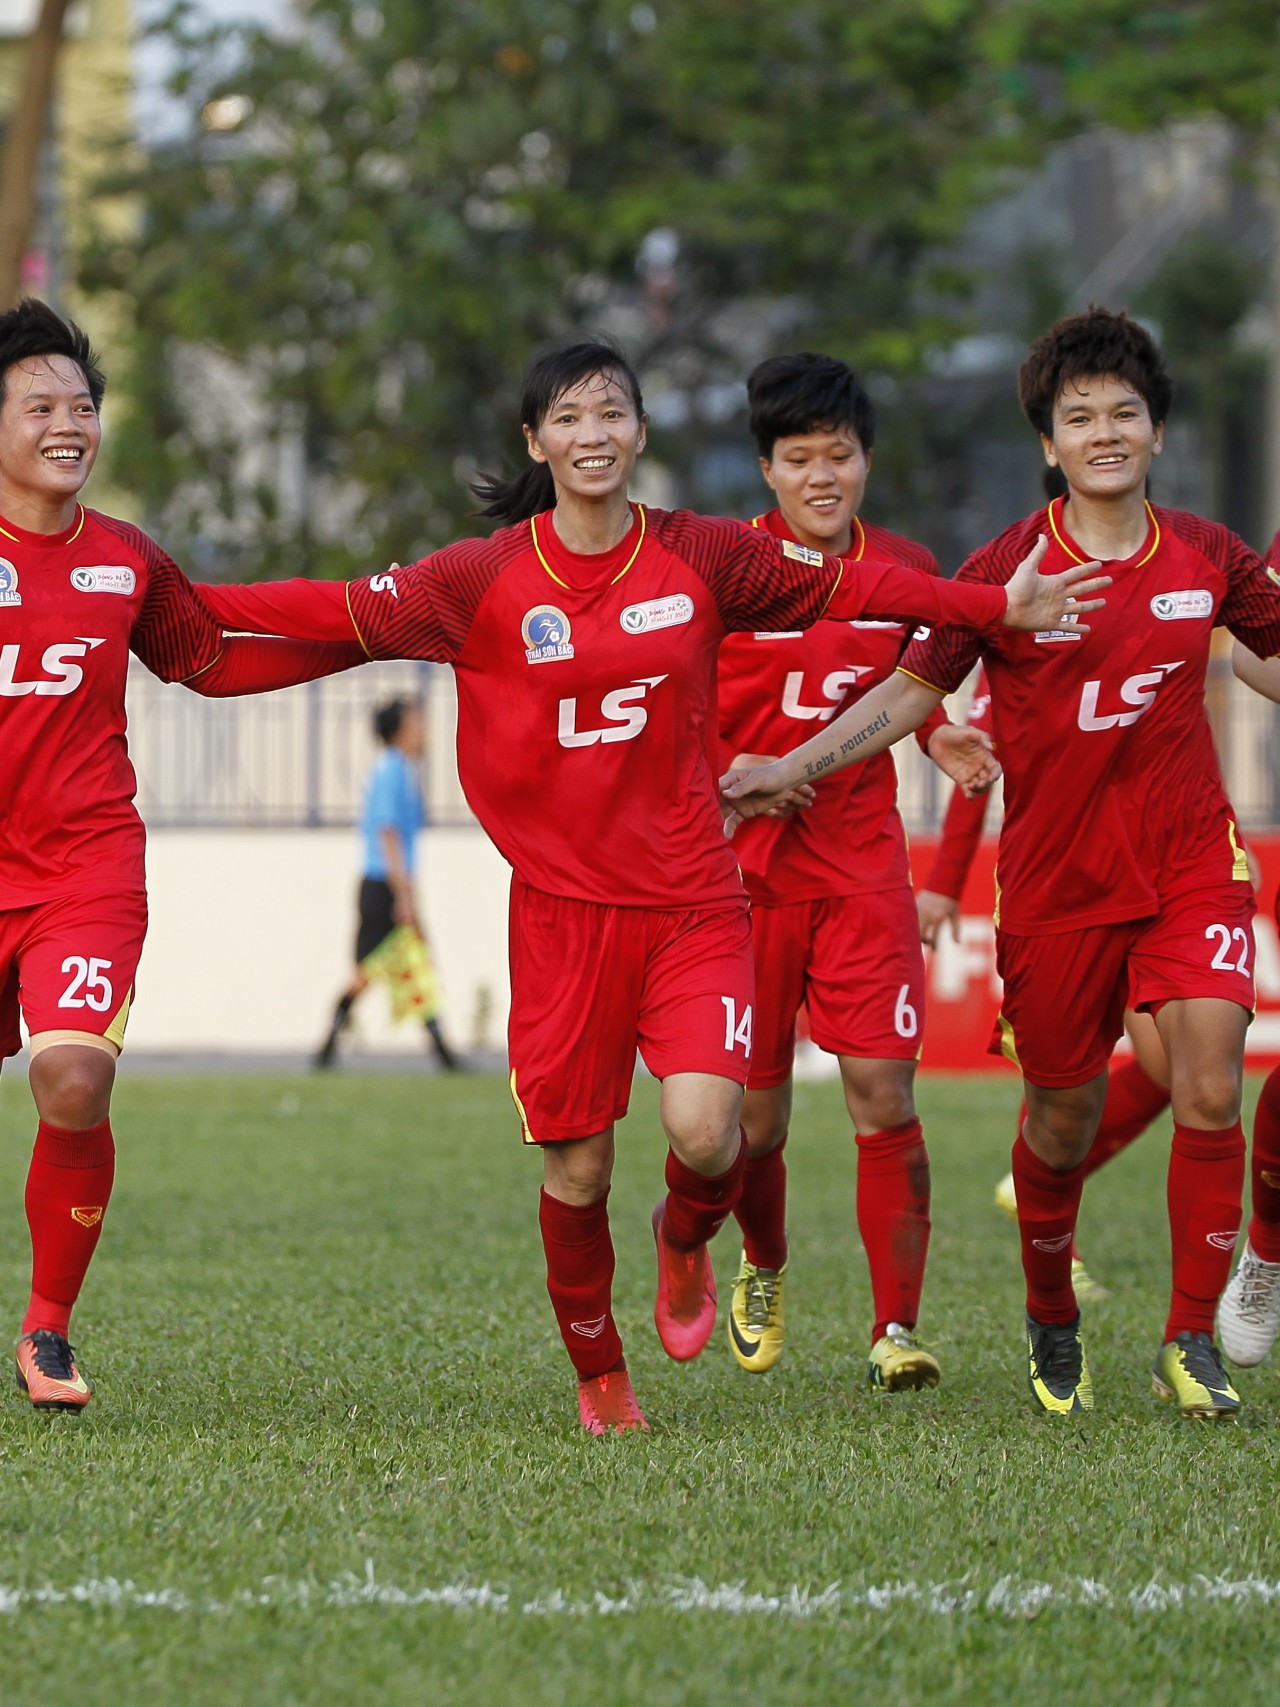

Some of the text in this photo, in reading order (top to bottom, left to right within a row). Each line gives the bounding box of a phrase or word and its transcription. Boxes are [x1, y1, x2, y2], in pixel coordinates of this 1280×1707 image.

[558, 685, 647, 748] LS
[1078, 670, 1163, 732] LS
[1205, 923, 1251, 978] 22
[58, 955, 113, 1012] 25
[894, 984, 918, 1038] 6
[721, 995, 752, 1058] 14
